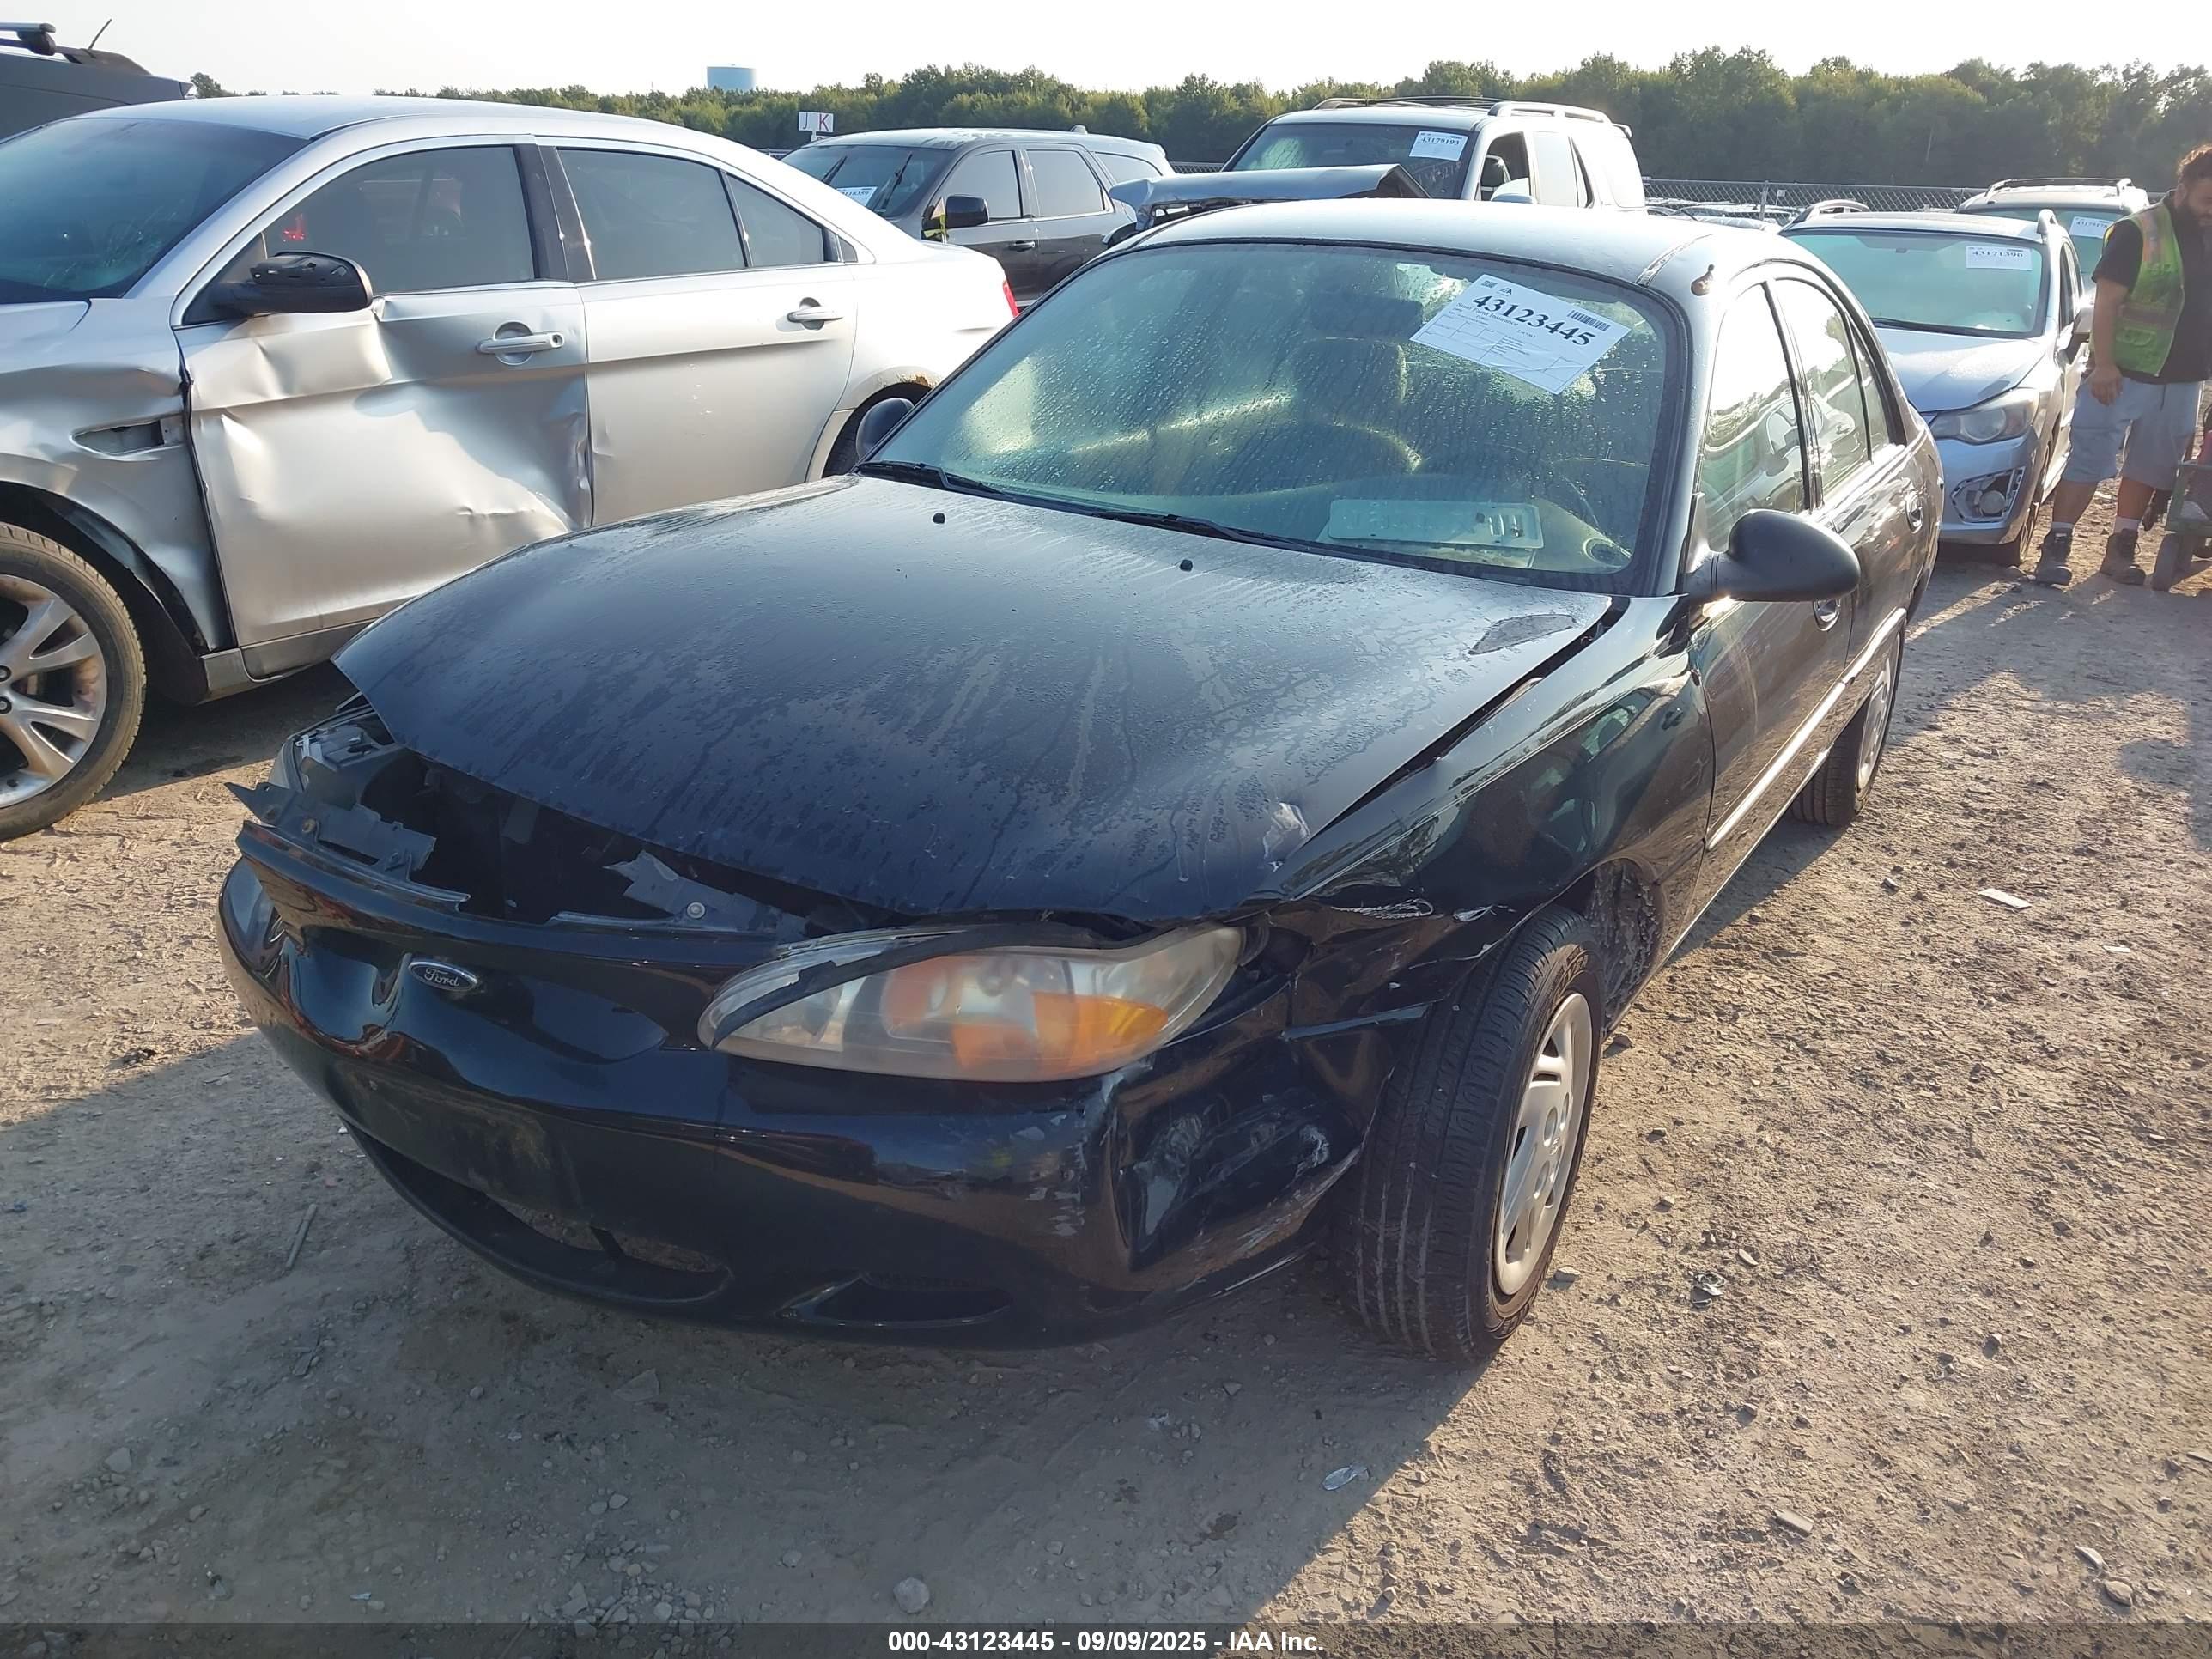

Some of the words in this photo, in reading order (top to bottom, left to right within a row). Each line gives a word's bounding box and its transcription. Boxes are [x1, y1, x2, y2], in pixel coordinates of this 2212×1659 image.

[803, 113, 808, 130] J
[819, 113, 830, 131] K
[1473, 295, 1596, 345] 43123445
[424, 968, 459, 987] Ford
